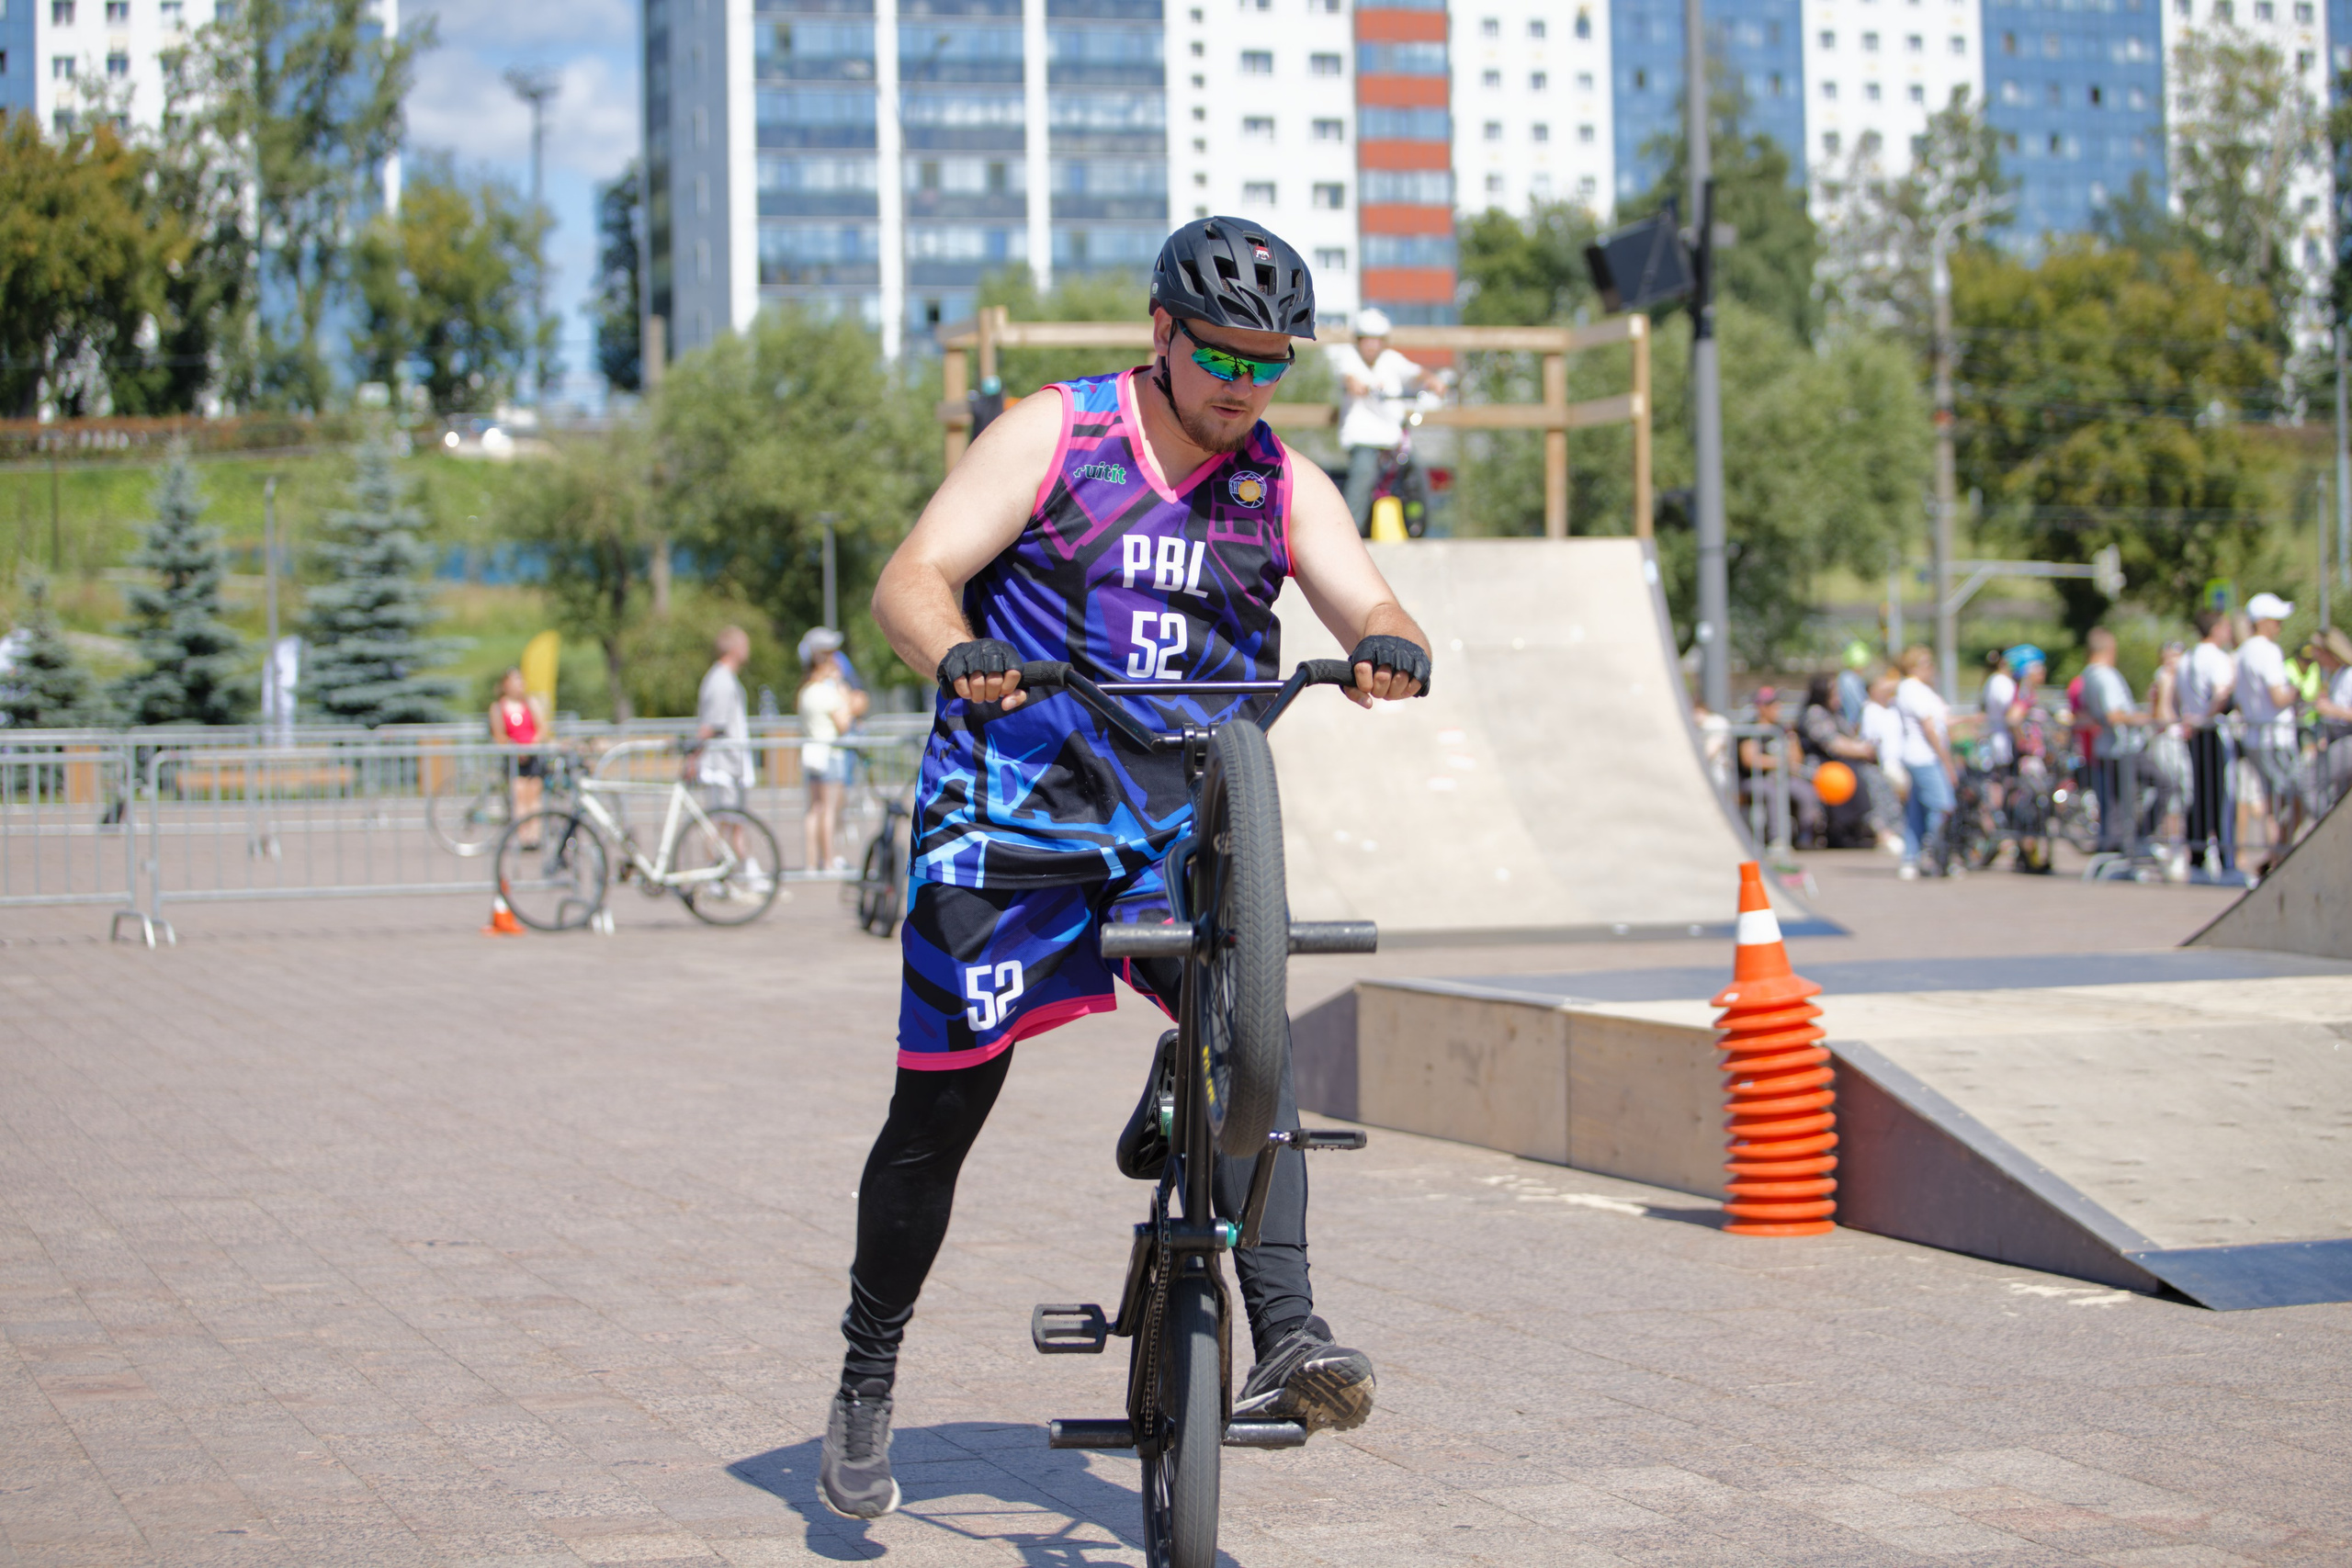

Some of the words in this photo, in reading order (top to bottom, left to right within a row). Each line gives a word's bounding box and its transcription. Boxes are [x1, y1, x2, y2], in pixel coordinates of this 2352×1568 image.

[1123, 534, 1208, 598] PBL
[1126, 610, 1187, 680] 52
[966, 960, 1024, 1032] 52
